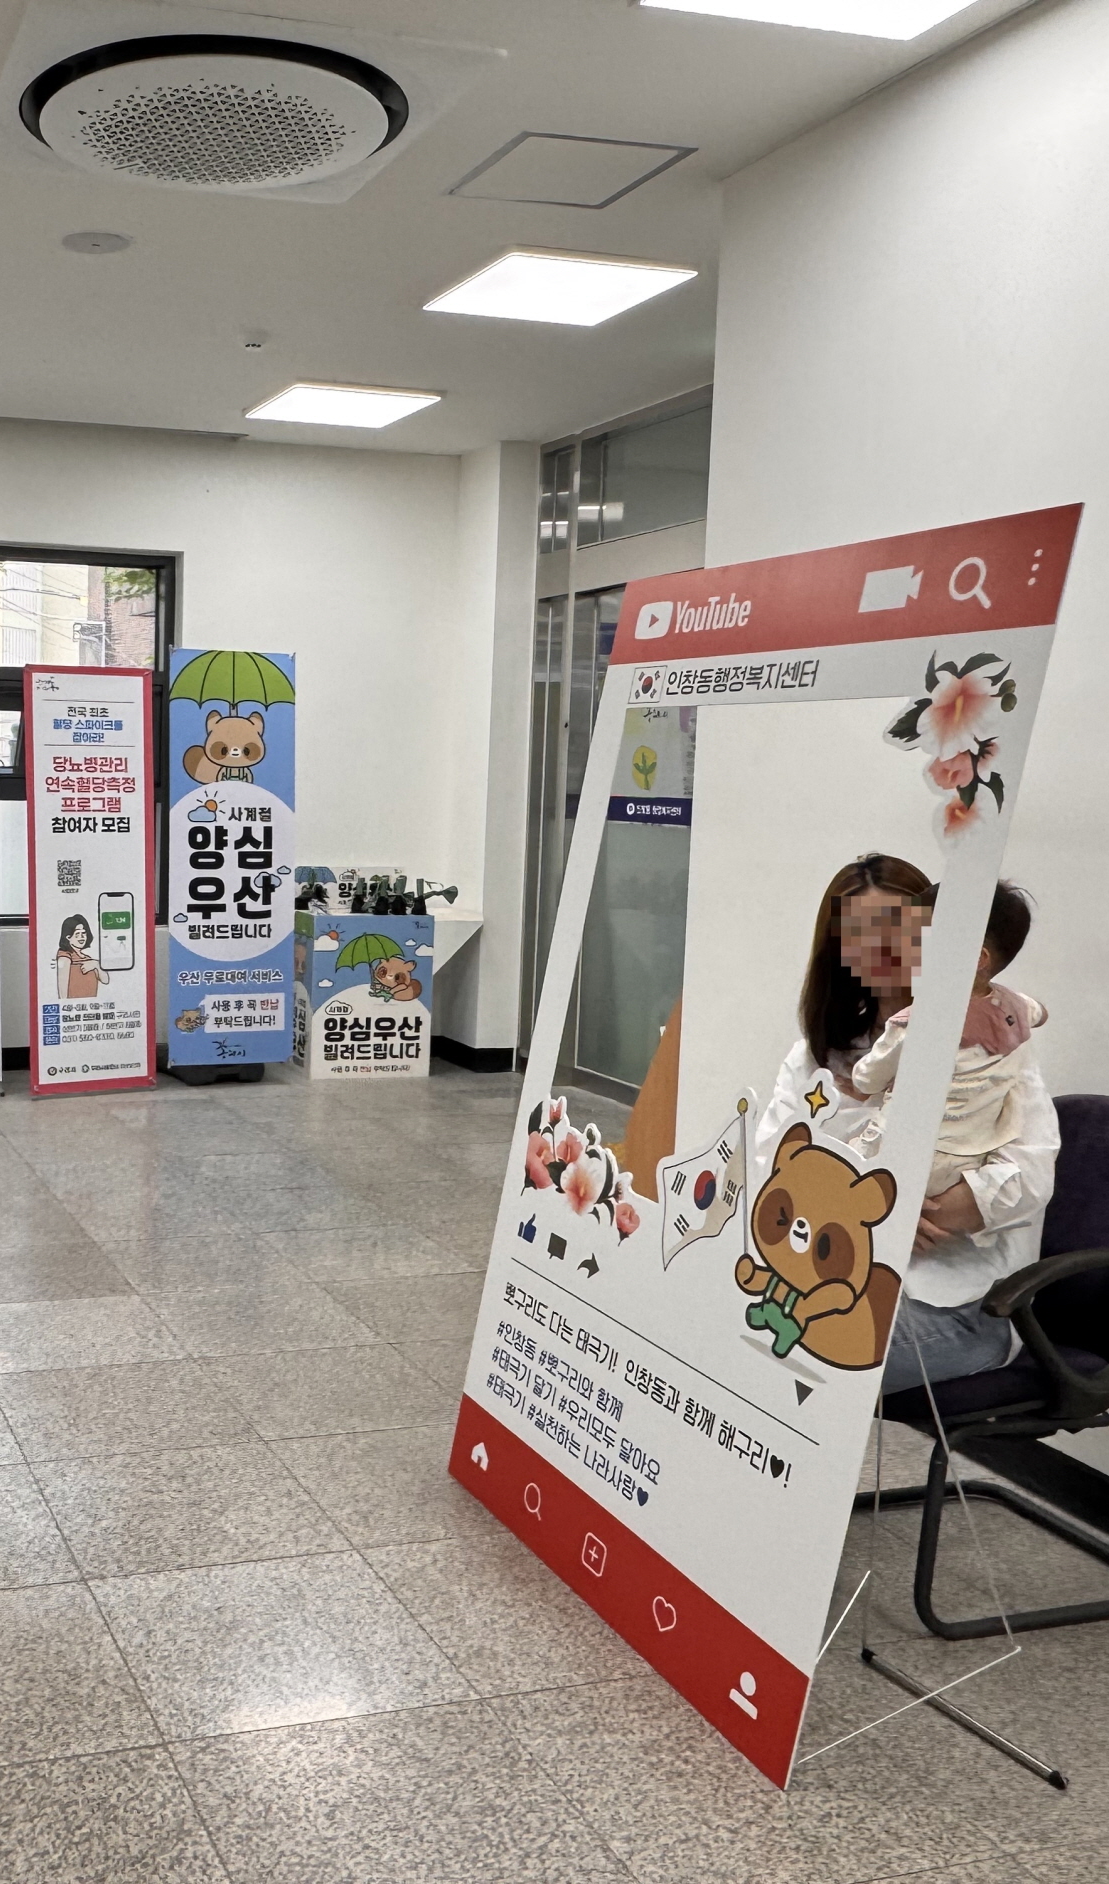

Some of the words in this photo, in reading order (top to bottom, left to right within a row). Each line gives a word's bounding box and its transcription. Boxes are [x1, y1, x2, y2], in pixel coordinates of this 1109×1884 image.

[675, 593, 752, 634] YouTube
[666, 659, 820, 696] 인창동행정복지센터
[67, 706, 87, 717] 전국
[52, 756, 129, 773] 당뇨병관리
[45, 776, 136, 793] 연속혈당측정
[61, 796, 122, 813] 프로그램
[228, 807, 272, 822] 사계절
[51, 816, 98, 834] 참여자
[100, 816, 131, 834] 모집
[188, 825, 273, 870] 양심
[187, 875, 276, 920] 우산
[188, 923, 272, 940] 빌려드립니다
[178, 970, 201, 986] 우산
[203, 969, 248, 985] 무료대여
[250, 969, 283, 984] 서비스
[211, 999, 231, 1011] 사용
[233, 999, 244, 1011] 후
[260, 998, 279, 1010] 반납
[214, 1015, 276, 1028] 부탁드립니다!
[324, 1016, 423, 1042] 양심우산
[323, 1043, 421, 1061] 빌려드립니다
[497, 1320, 538, 1361] #인창동
[596, 1387, 624, 1423] 함께
[549, 1311, 574, 1344] 다는
[575, 1328, 619, 1373] 태극기!
[624, 1359, 681, 1414] 인창동과
[683, 1397, 716, 1438] 함께
[486, 1372, 526, 1414] #태극기
[527, 1403, 581, 1459] #실천하는
[492, 1346, 532, 1387] #태극기
[532, 1374, 557, 1407] 달기
[558, 1395, 617, 1449] #우리모두
[618, 1437, 661, 1486] 달아요
